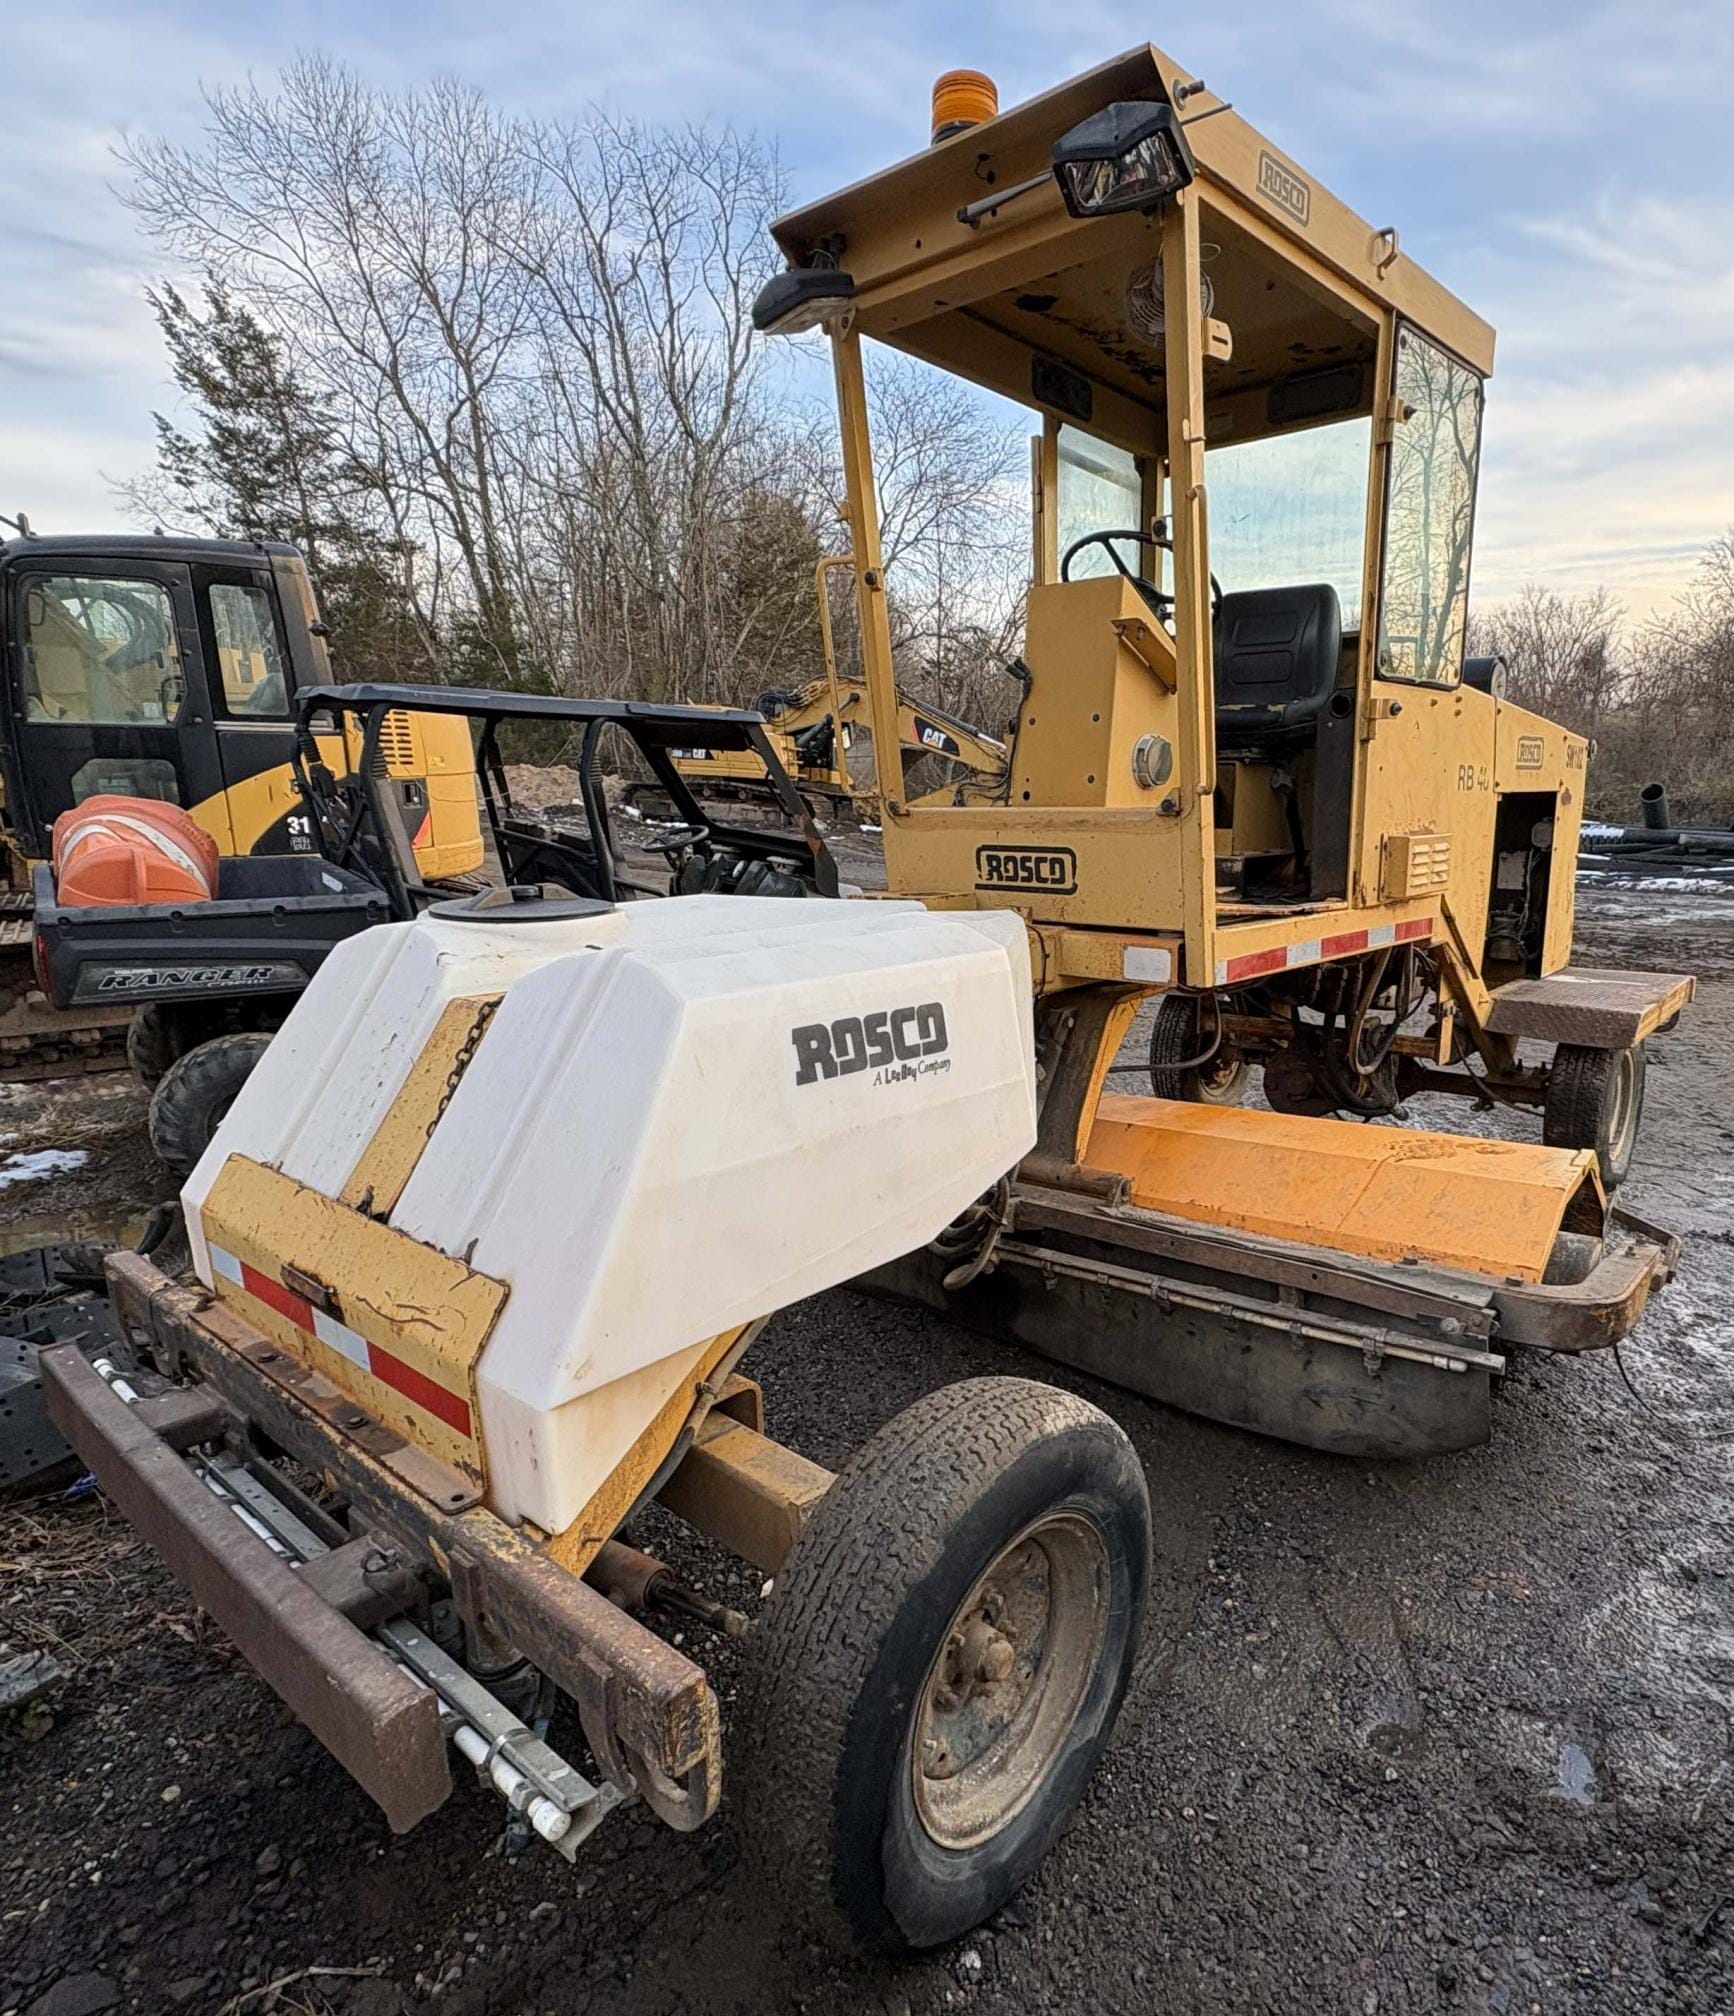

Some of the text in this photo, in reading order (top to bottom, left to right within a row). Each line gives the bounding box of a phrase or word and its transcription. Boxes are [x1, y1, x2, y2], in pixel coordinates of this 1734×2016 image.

[1262, 160, 1306, 216] ROSCO
[922, 728, 948, 749] CAT
[1519, 743, 1541, 763] ROSCO
[1457, 764, 1475, 791] RB
[985, 854, 1066, 885] ROSCO
[98, 966, 274, 990] RANGER
[792, 1001, 949, 1086] ROSCO
[872, 1071, 883, 1087] A
[917, 1058, 951, 1076] Company
